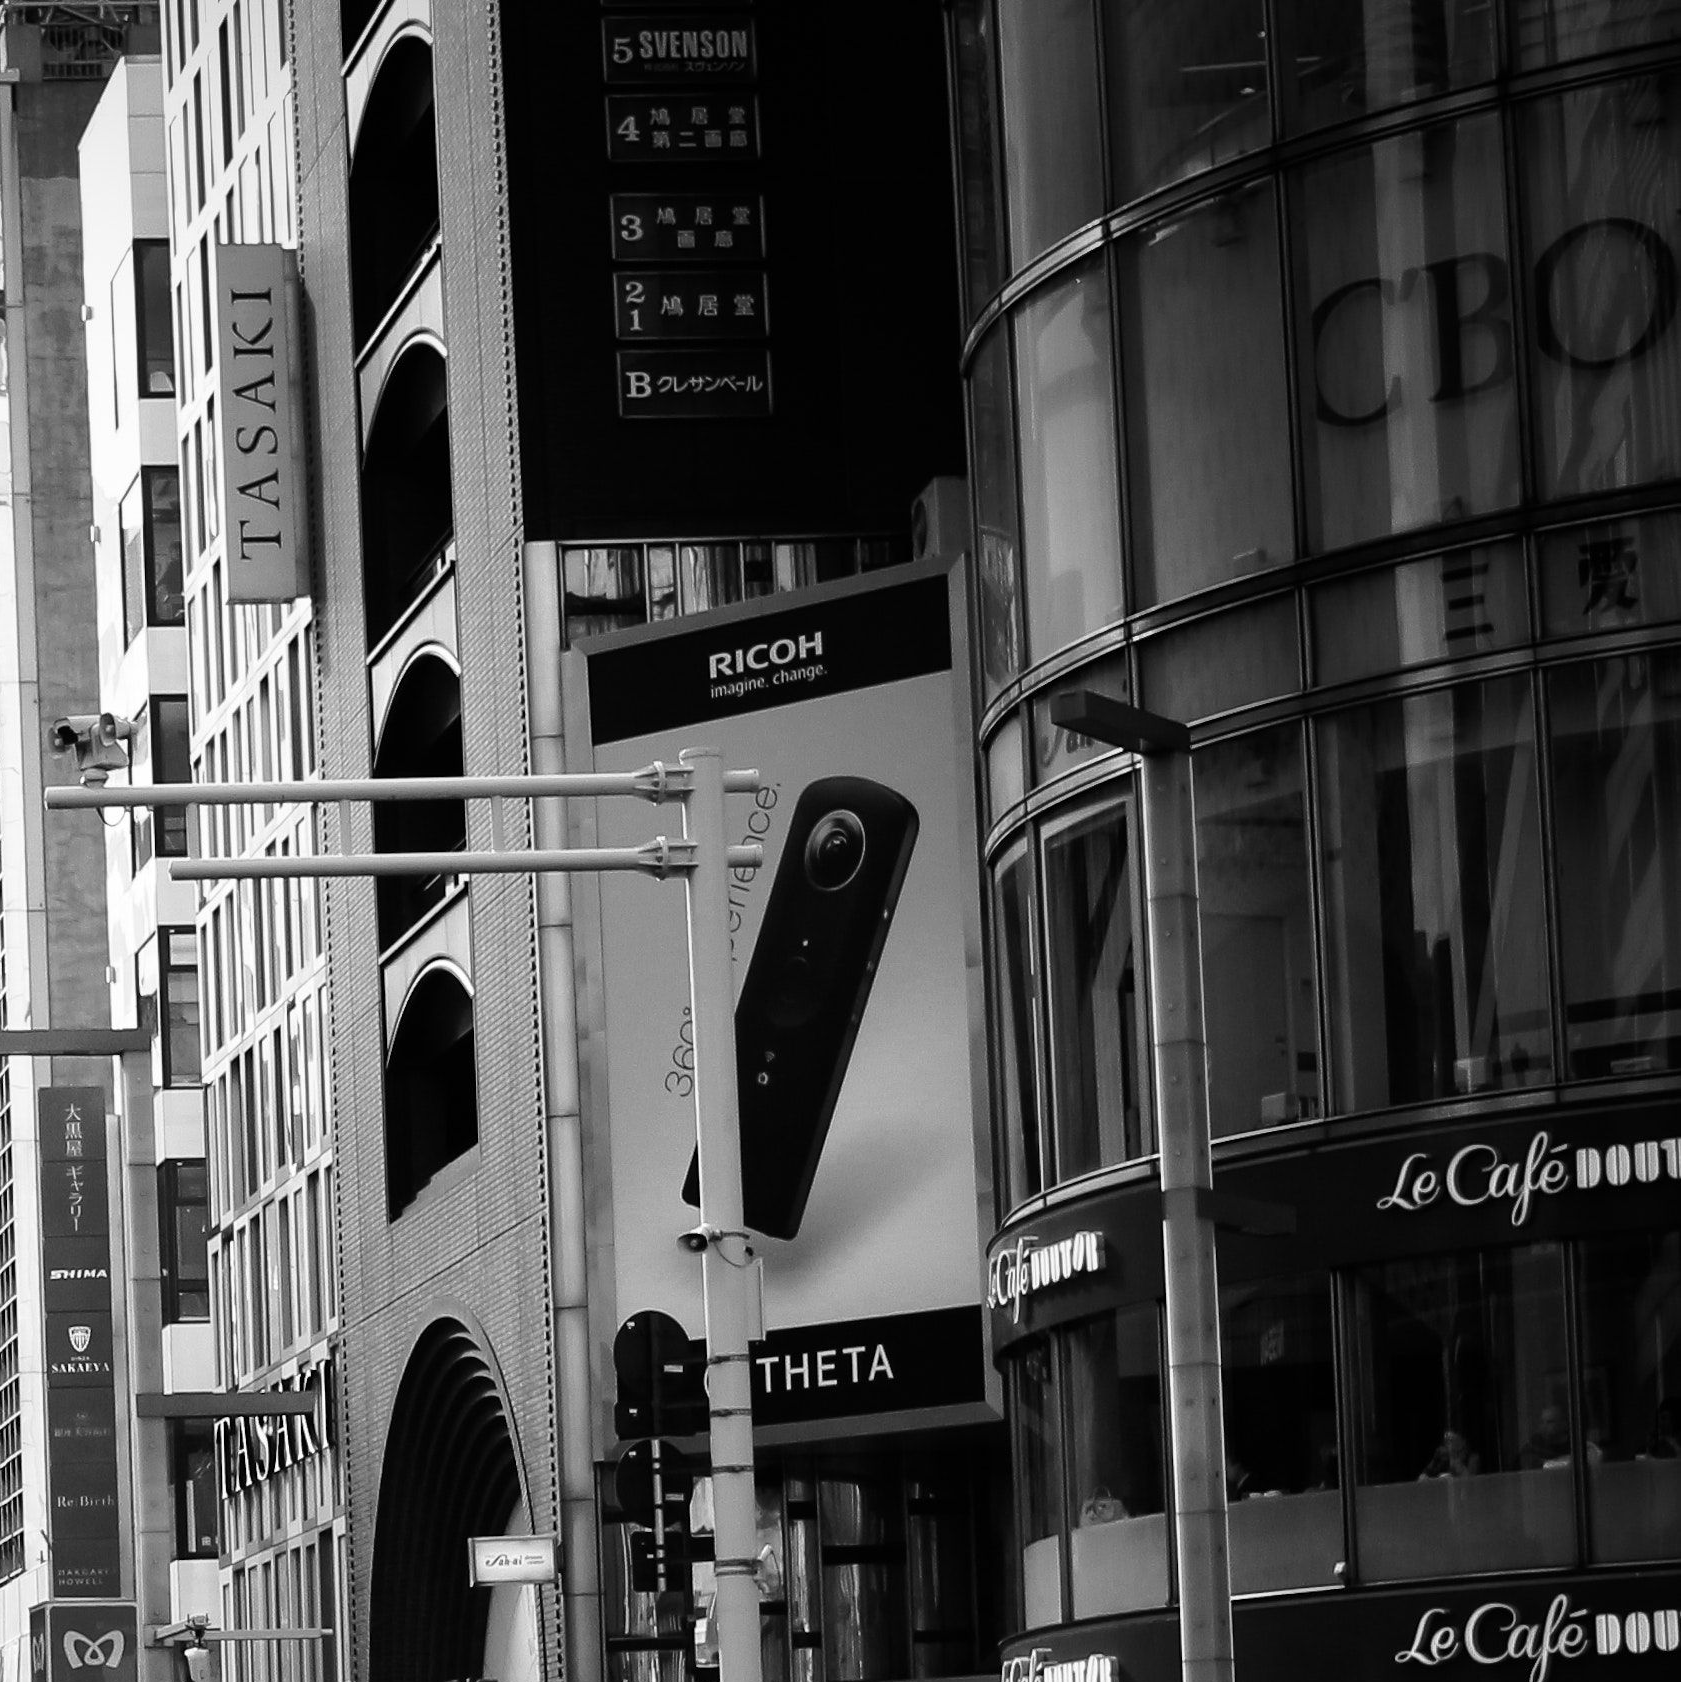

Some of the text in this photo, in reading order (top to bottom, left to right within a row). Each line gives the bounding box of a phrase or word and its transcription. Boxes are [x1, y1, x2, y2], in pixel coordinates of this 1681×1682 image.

[612, 29, 747, 64] 5 SVENSON
[616, 115, 640, 142] 4
[620, 214, 644, 242] 3
[625, 281, 645, 304] 2
[630, 309, 643, 332] 1
[625, 371, 764, 399] B クレサンベール
[230, 286, 281, 561] TASAKI
[708, 630, 824, 680] RICOH
[710, 661, 828, 699] imagine. change.
[64, 1102, 84, 1158] 大黒屋
[65, 1165, 85, 1232] ギャラリー
[1375, 1151, 1441, 1211] Le
[1444, 1131, 1571, 1227] Café
[49, 1268, 108, 1281] SHIMA
[995, 1235, 1039, 1325] Café
[51, 1361, 110, 1374] SAKAEYA
[755, 1343, 895, 1394] THETA
[213, 1359, 330, 1500] TASAKI
[1394, 1607, 1459, 1667] Le
